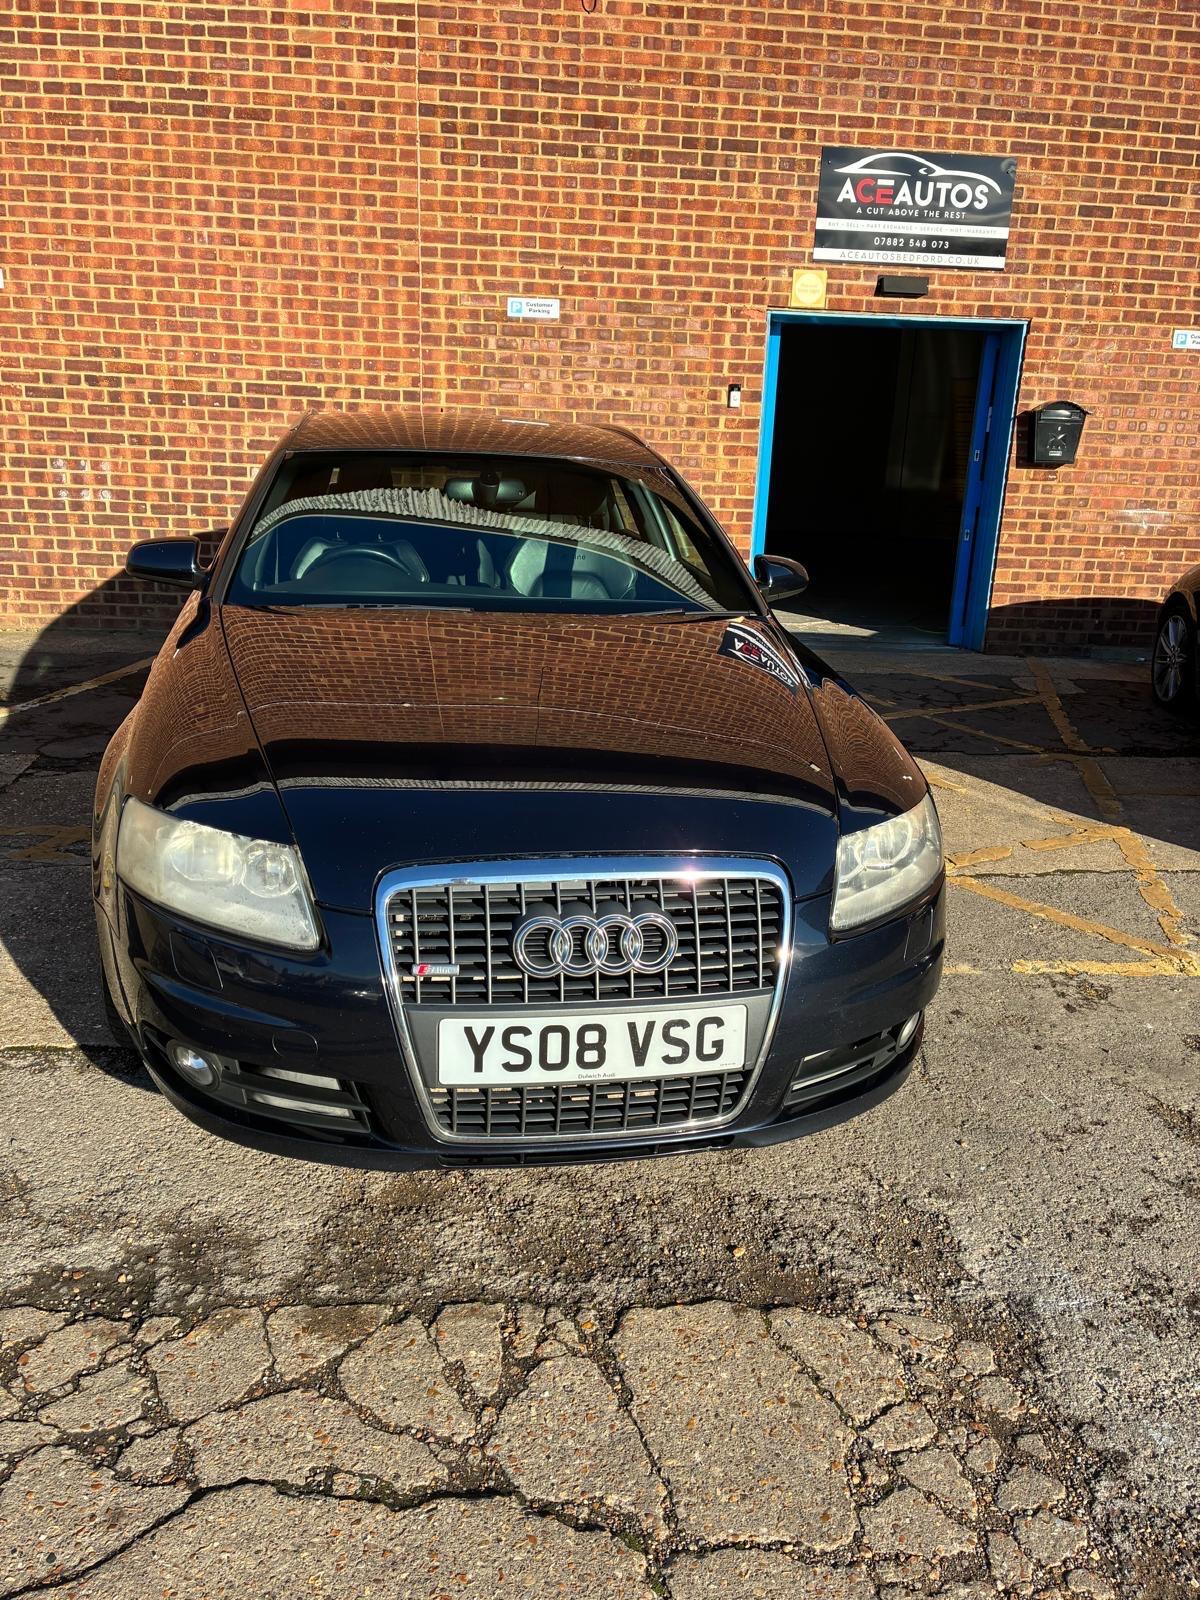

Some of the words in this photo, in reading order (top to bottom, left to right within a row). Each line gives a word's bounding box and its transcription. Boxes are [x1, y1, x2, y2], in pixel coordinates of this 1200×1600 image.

[866, 207, 884, 215] CUT
[888, 208, 919, 217] ABOVE
[924, 210, 940, 218] THE
[944, 211, 967, 219] REST
[873, 237, 905, 247] 07882
[909, 238, 927, 249] 548
[932, 239, 950, 250] 073
[839, 250, 980, 265] ACEAUTOSBEDFORD.CO.UK
[463, 1023, 607, 1073] YS08
[627, 1016, 725, 1068] VSG
[578, 1072, 602, 1080] Dulwich
